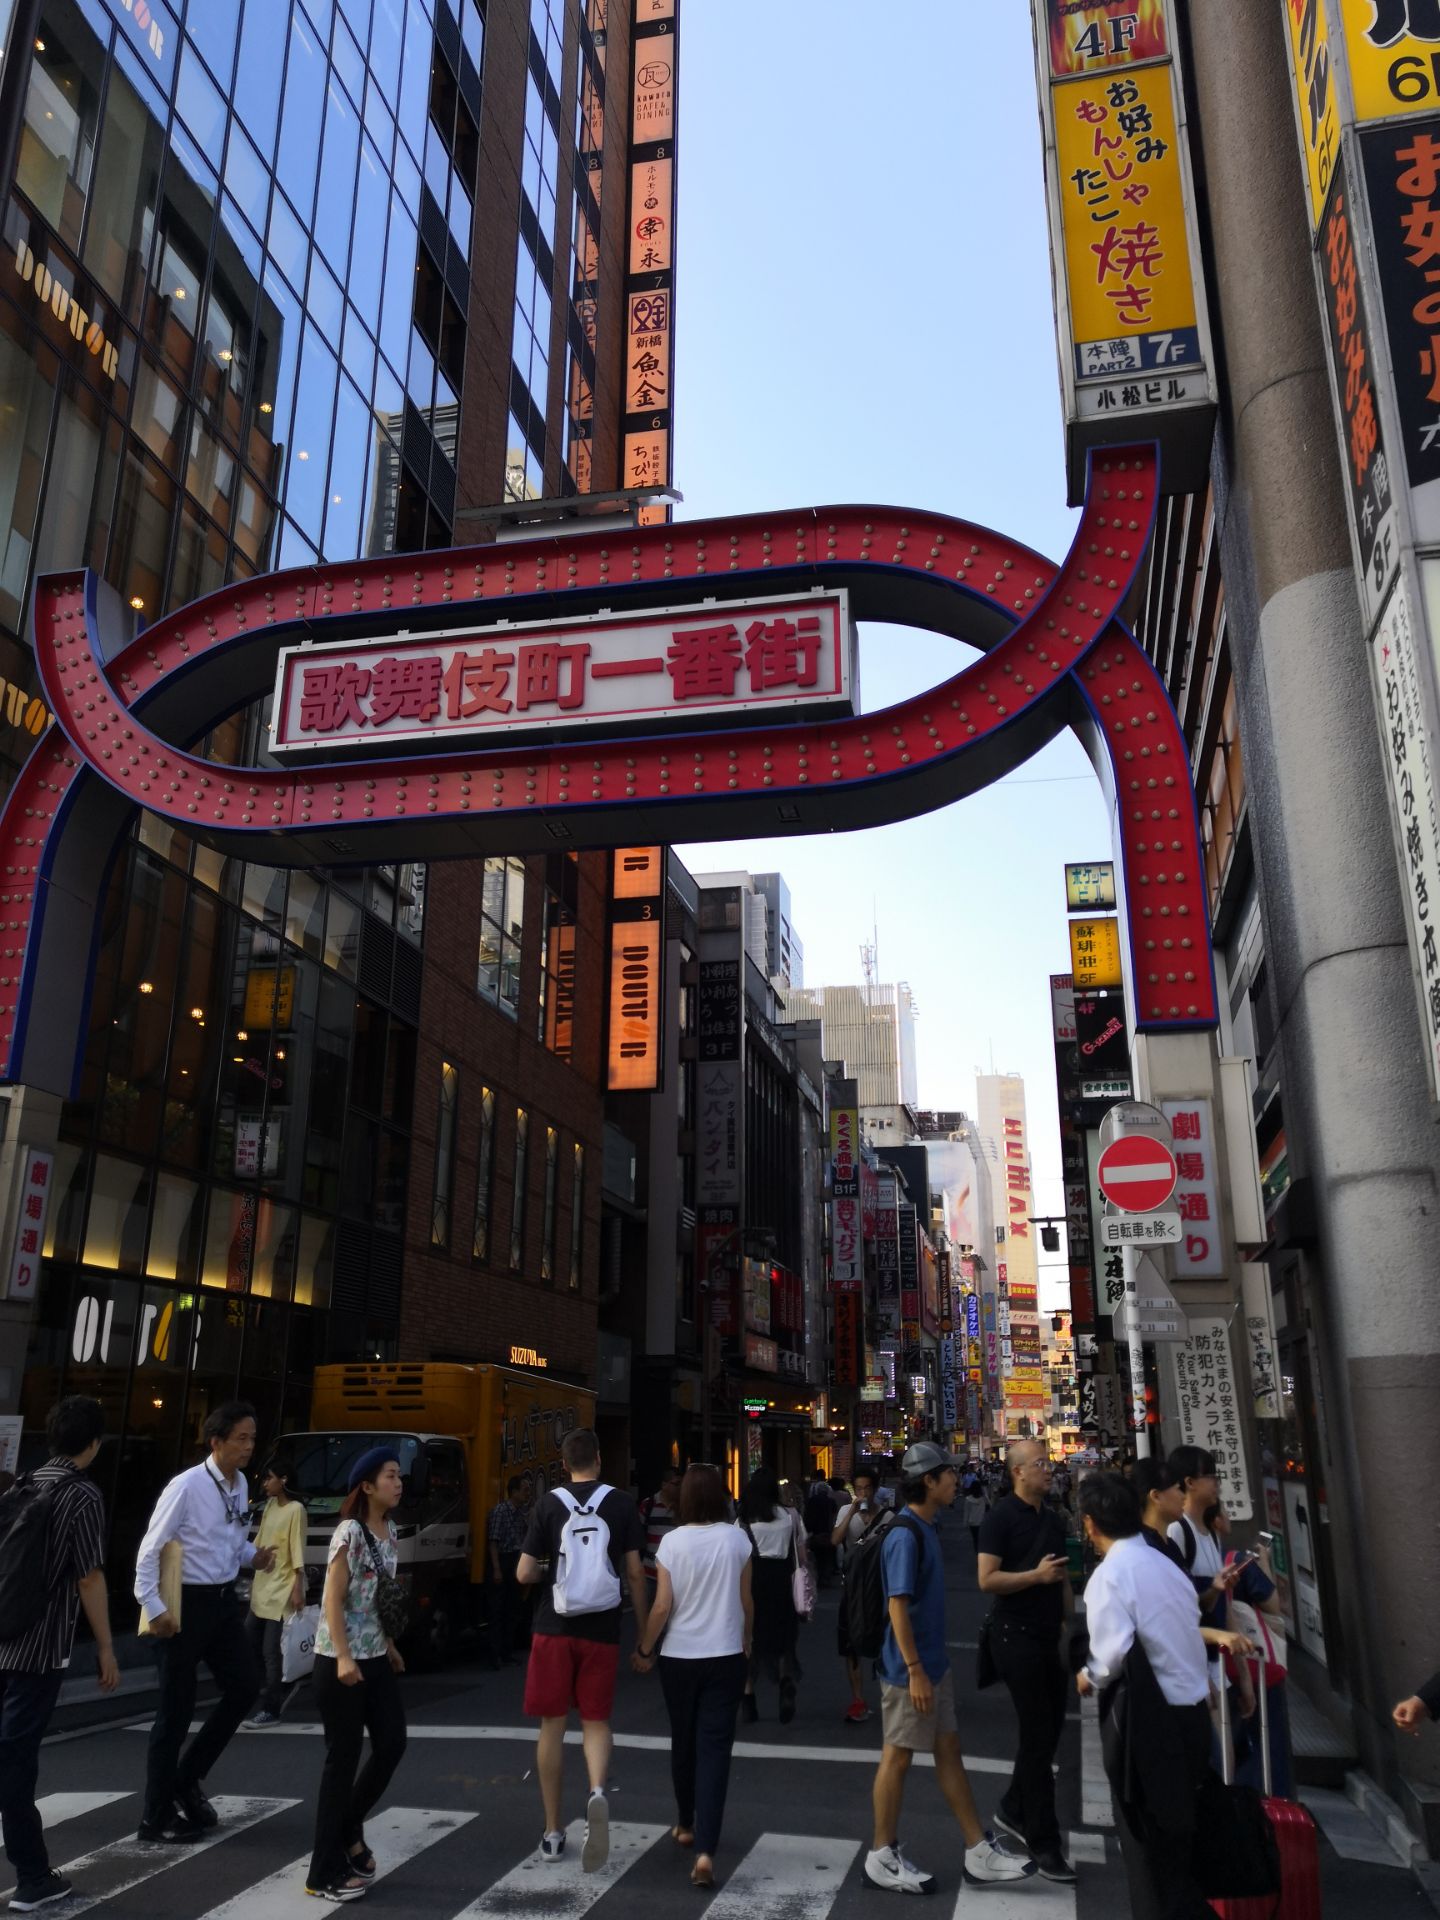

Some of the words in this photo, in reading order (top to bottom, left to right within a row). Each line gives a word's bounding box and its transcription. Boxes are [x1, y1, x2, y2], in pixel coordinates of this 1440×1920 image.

[659, 23, 667, 34] 9
[1074, 13, 1139, 58] 4F
[637, 90, 671, 103] kawara
[636, 110, 670, 121] DINING
[1107, 80, 1168, 163] お好み
[657, 148, 665, 159] 8
[1076, 99, 1149, 206] もんじゃ
[1318, 107, 1334, 195] 6F
[1070, 167, 1120, 222] たこ
[655, 276, 663, 288] 7
[1090, 221, 1165, 325] 焼き
[15, 238, 120, 382] DOUTOR
[636, 335, 662, 349] 新橋
[1087, 340, 1130, 359] 本陣
[1148, 333, 1186, 364] 7F
[632, 351, 666, 408] 魚金
[1089, 355, 1136, 374] PART2
[1097, 379, 1186, 411] 小松ビル
[652, 416, 661, 429] 6
[1373, 524, 1392, 593] 8F
[299, 616, 822, 734] 歌舞伎町一番街
[642, 905, 651, 919] 3
[1079, 973, 1097, 984] 5F
[620, 945, 650, 1059] DOUTOR
[705, 1042, 734, 1055] 3F
[834, 1183, 857, 1195] B1F
[1172, 1112, 1210, 1262] 劇場通り
[17, 1161, 48, 1286] 劇場通り
[1107, 1221, 1176, 1240] 自転車を除く
[968, 1294, 977, 1330] カラオケ
[510, 1346, 537, 1366] SUZUYA
[1175, 1352, 1189, 1391] Security
[1186, 1354, 1197, 1376] Your
[1189, 1379, 1201, 1410] Safety
[1195, 1335, 1228, 1485] 防犯カメラ作動中
[1211, 1326, 1244, 1494] みなさまの安全を守ります
[1181, 1394, 1193, 1432] Camera
